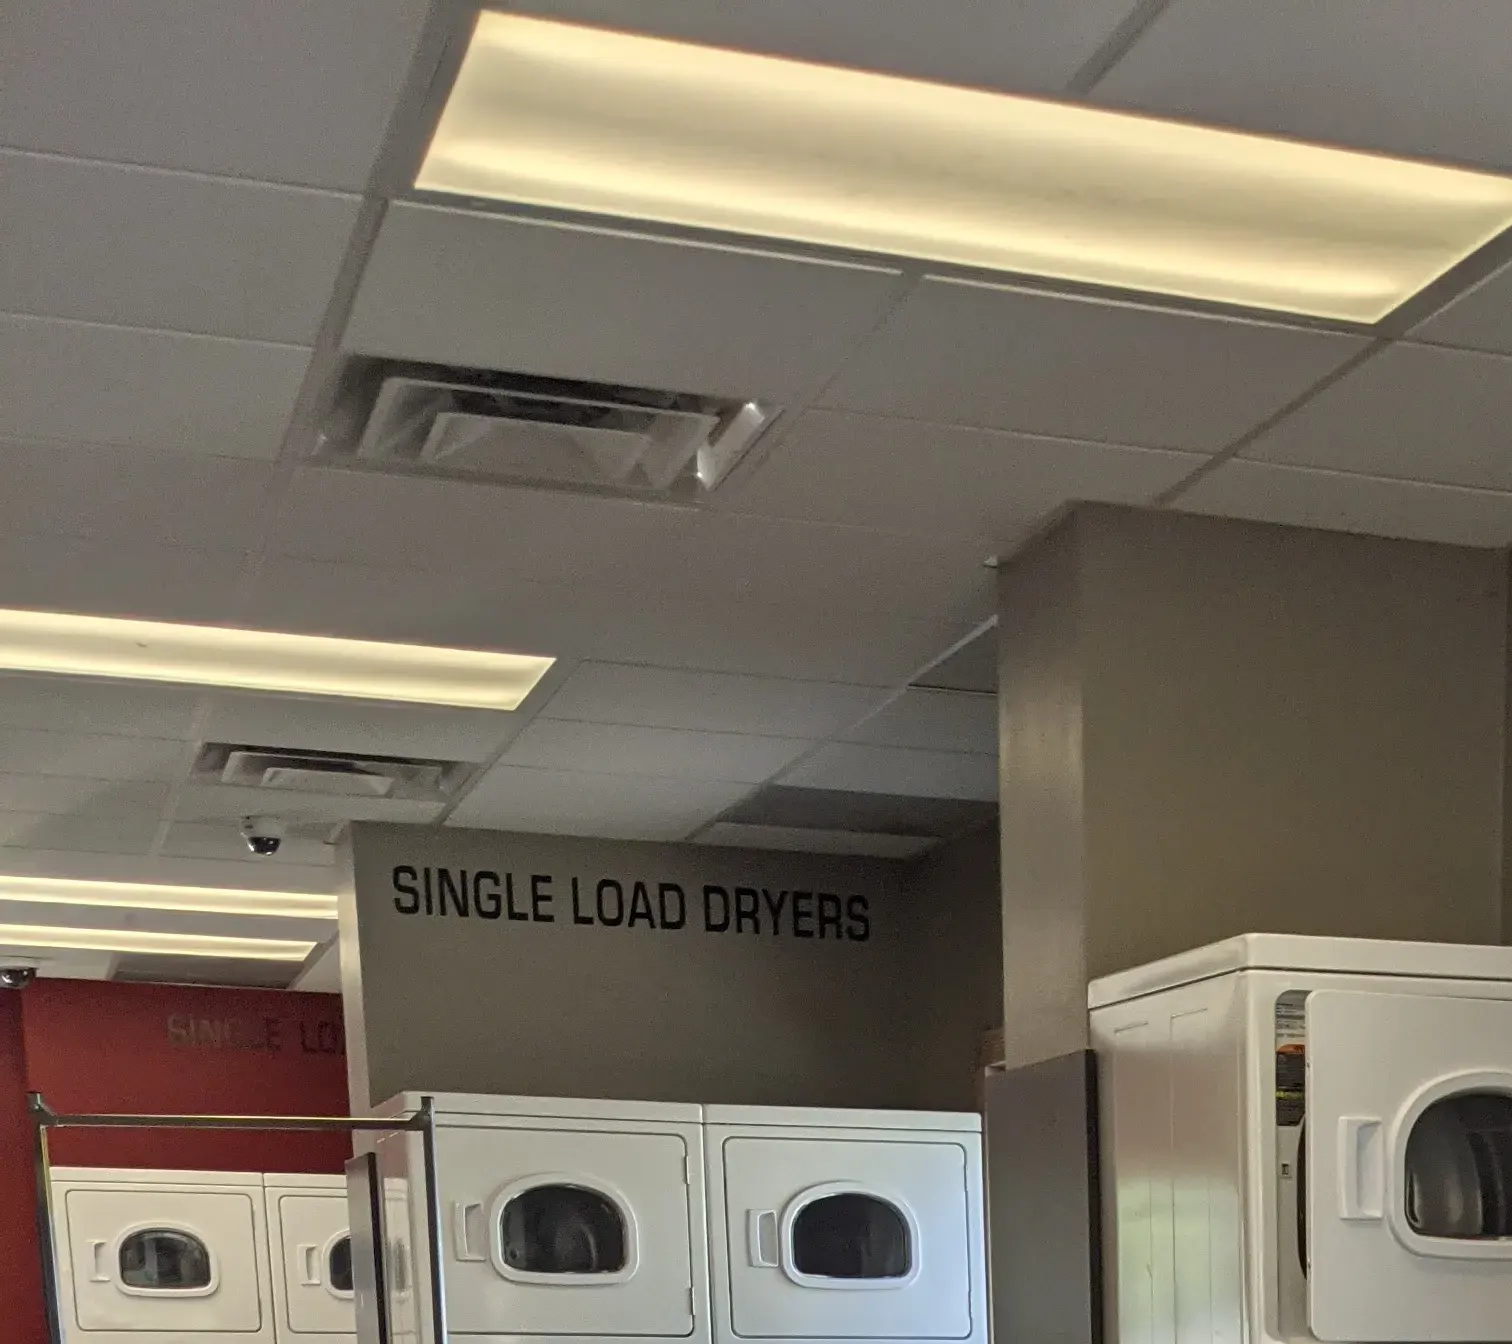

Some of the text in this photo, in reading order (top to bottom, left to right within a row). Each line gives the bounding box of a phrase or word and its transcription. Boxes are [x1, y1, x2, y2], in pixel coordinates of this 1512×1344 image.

[392, 865, 870, 942] SINGLE LOAD DRYERS
